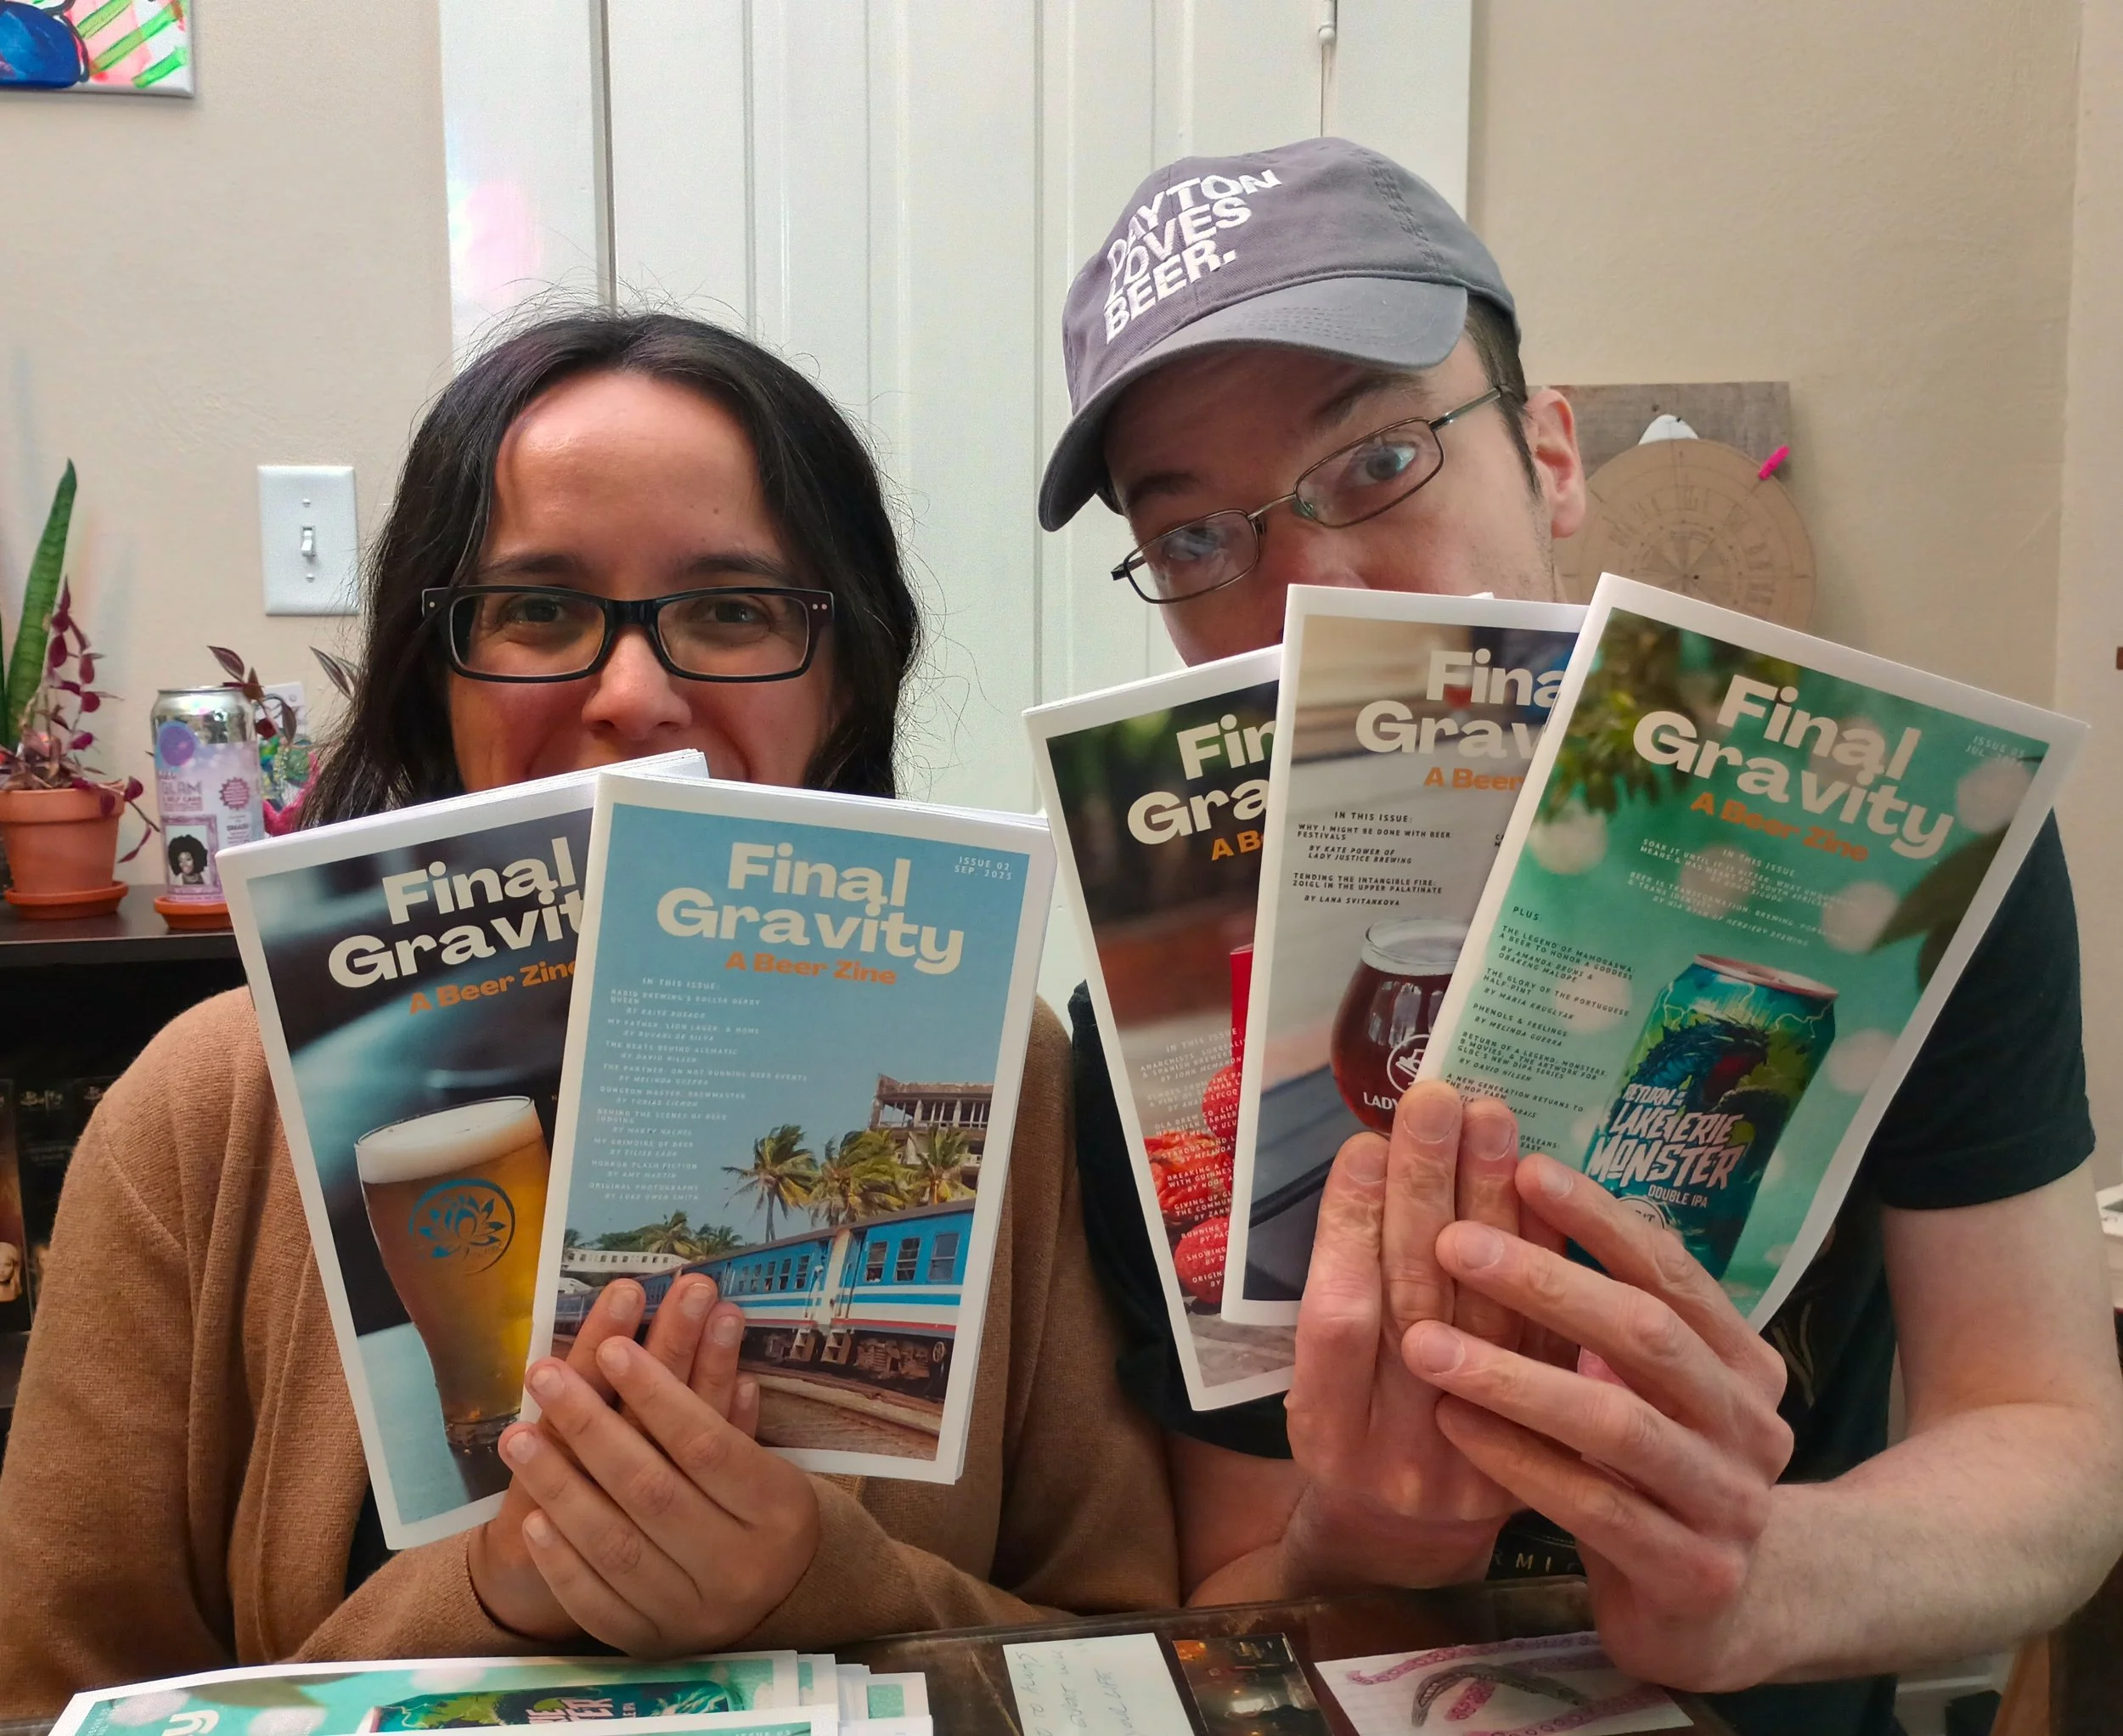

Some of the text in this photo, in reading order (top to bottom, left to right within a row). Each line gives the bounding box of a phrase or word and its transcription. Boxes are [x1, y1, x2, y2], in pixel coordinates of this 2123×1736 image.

[1107, 169, 1282, 284] DAYTON
[1104, 196, 1252, 311] LOVES
[1104, 240, 1236, 345] BEER.
[1426, 648, 1568, 708] Fina
[1716, 674, 1922, 781] Final
[1176, 713, 1276, 781] Fin
[1973, 736, 2008, 753] ISSUE
[1423, 767, 1523, 791] A Beer
[1633, 711, 1954, 860] Gravity
[1128, 780, 1270, 845] Gra
[1351, 812, 1374, 820] THIS
[1297, 831, 1346, 840] FESTIVALS
[1329, 825, 1358, 833] MIGHT
[1690, 792, 1870, 863] A Beer Zine
[1211, 830, 1263, 861] A B
[1373, 855, 1411, 864] BREWING
[959, 856, 1010, 871] ISSUE 02
[984, 869, 1011, 880] 2023
[1739, 854, 1763, 867] THIS
[382, 837, 577, 925] Final
[728, 842, 911, 908] Final
[1292, 879, 1320, 888] ZOIGL
[1389, 885, 1442, 893] PALATINATE
[1293, 872, 1333, 881] TENDING
[1358, 876, 1410, 885] INTANGIBLE
[1345, 897, 1399, 905] SVITANKOVA
[656, 887, 965, 975] Gravity
[1501, 925, 1519, 935] THE
[1521, 933, 1557, 949] LEGEND
[1560, 944, 1572, 953] OF
[724, 951, 897, 984] A Beer Zine
[1501, 944, 1512, 953] BY
[1514, 950, 1552, 967] AMANDA
[1555, 963, 1584, 977] BRUNS
[1507, 935, 1532, 948] BEER
[1535, 944, 1547, 953] TO
[1549, 950, 1581, 964] HONOR
[1592, 963, 1633, 980] GODDESS
[1541, 967, 1578, 983] MALOPE
[409, 993, 432, 1015] A
[436, 974, 515, 1006] Beer
[1484, 987, 1495, 995] BY
[1498, 992, 1527, 1006] MARIA
[1485, 967, 1629, 1017] THE GLORY OF THE PORTUGUESE
[1472, 1002, 1514, 1021] PHENOLS
[1526, 1020, 1568, 1037] FEELINGS
[1489, 1020, 1527, 1037] MELINDA
[1529, 1033, 1563, 1047] GUERRA
[1461, 1030, 1497, 1047] RETURN
[1500, 1043, 1512, 1051] OF
[1458, 1056, 1532, 1084] BY DAVID NILSEN
[1490, 1055, 1509, 1066] NEW
[1512, 1060, 1532, 1072] DIPA
[1535, 1066, 1564, 1081] SERIES
[1518, 1055, 1535, 1065] THE
[1538, 1059, 1577, 1077] ARTWORK
[1580, 1070, 1596, 1081] FOR
[1456, 1074, 1475, 1086] NEW
[1477, 1078, 1529, 1102] GENERATION
[1532, 1093, 1568, 1111] RETURNS
[1573, 1104, 1584, 1113] TO
[1464, 1084, 1481, 1095] HOP
[1484, 1088, 1506, 1102] FARM
[1623, 1083, 1675, 1105] RETURN
[1609, 1102, 1743, 1145] LAKE ERIE
[1585, 1135, 1747, 1189] MONSTER
[1174, 1197, 1203, 1210] GIVING
[1648, 1184, 1708, 1208] DOUBLE IPA
[1175, 1208, 1191, 1217] THE
